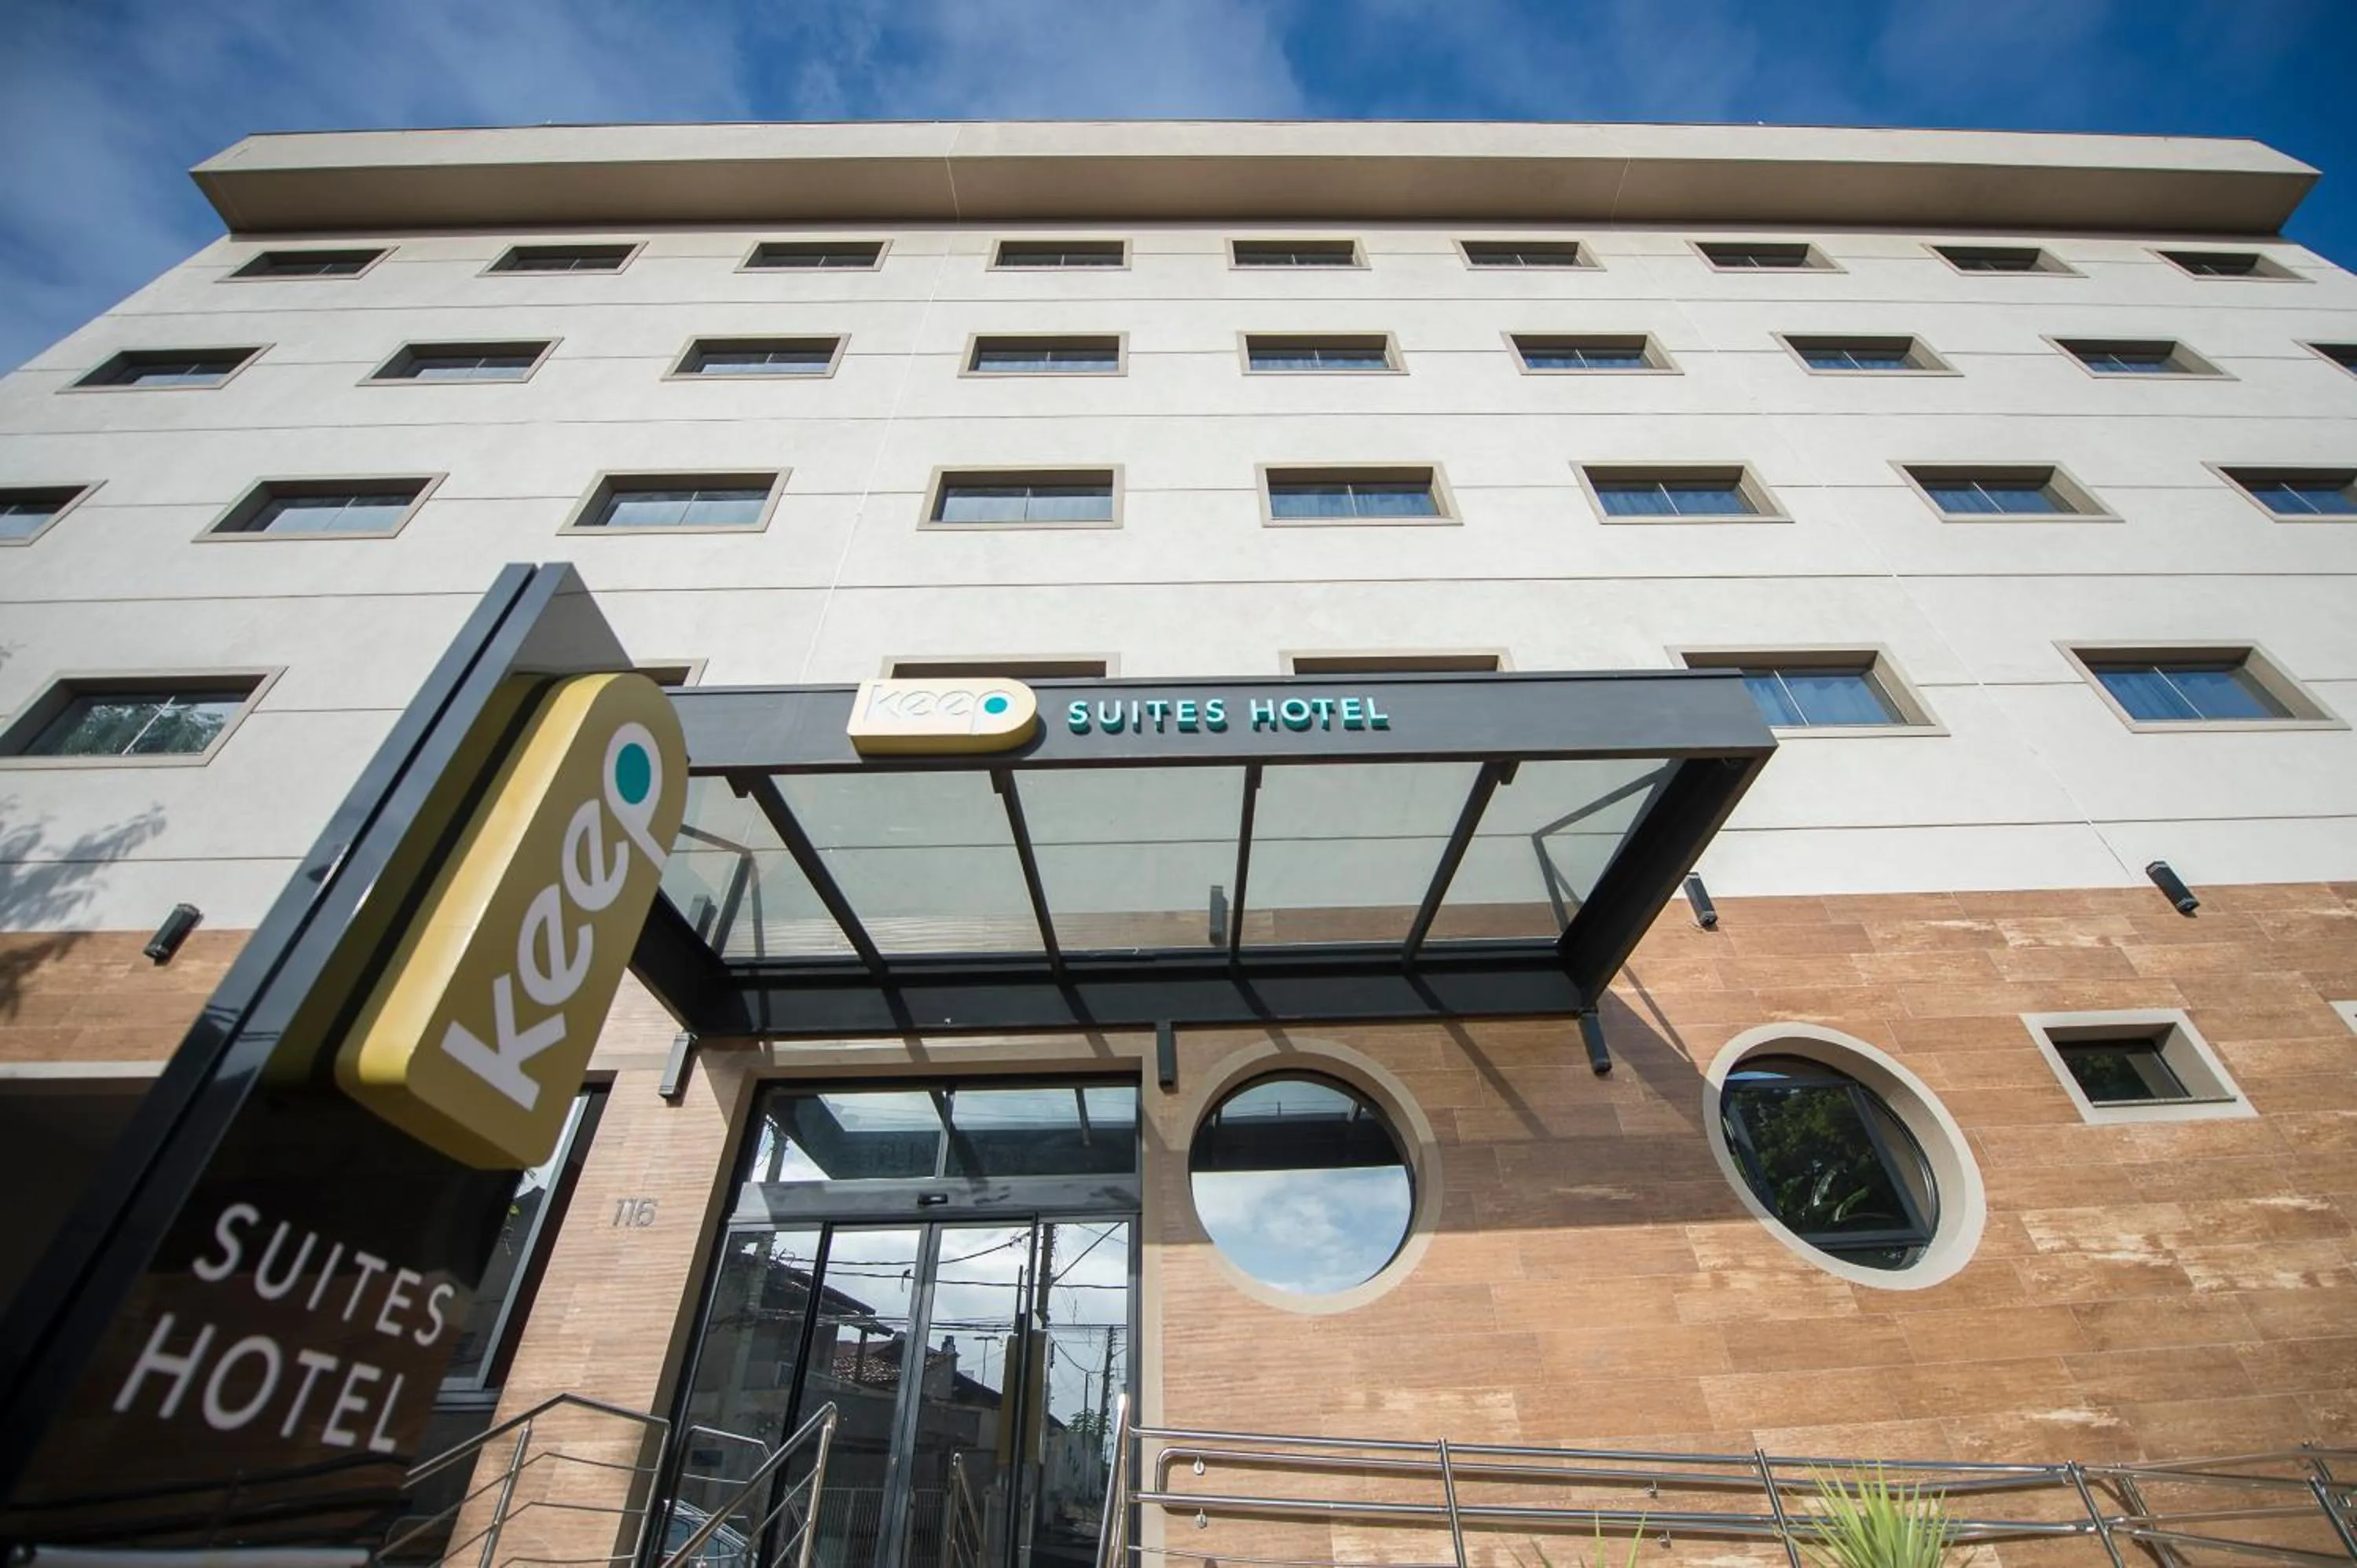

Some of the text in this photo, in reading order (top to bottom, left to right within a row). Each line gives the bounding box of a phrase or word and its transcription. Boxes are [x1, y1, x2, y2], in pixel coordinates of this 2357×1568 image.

[862, 683, 1391, 735] keep SUITES HOTEL
[439, 721, 670, 1112] keep
[192, 1202, 455, 1347] SUITES
[612, 1198, 658, 1228] 116
[112, 1312, 406, 1453] HOTEL
